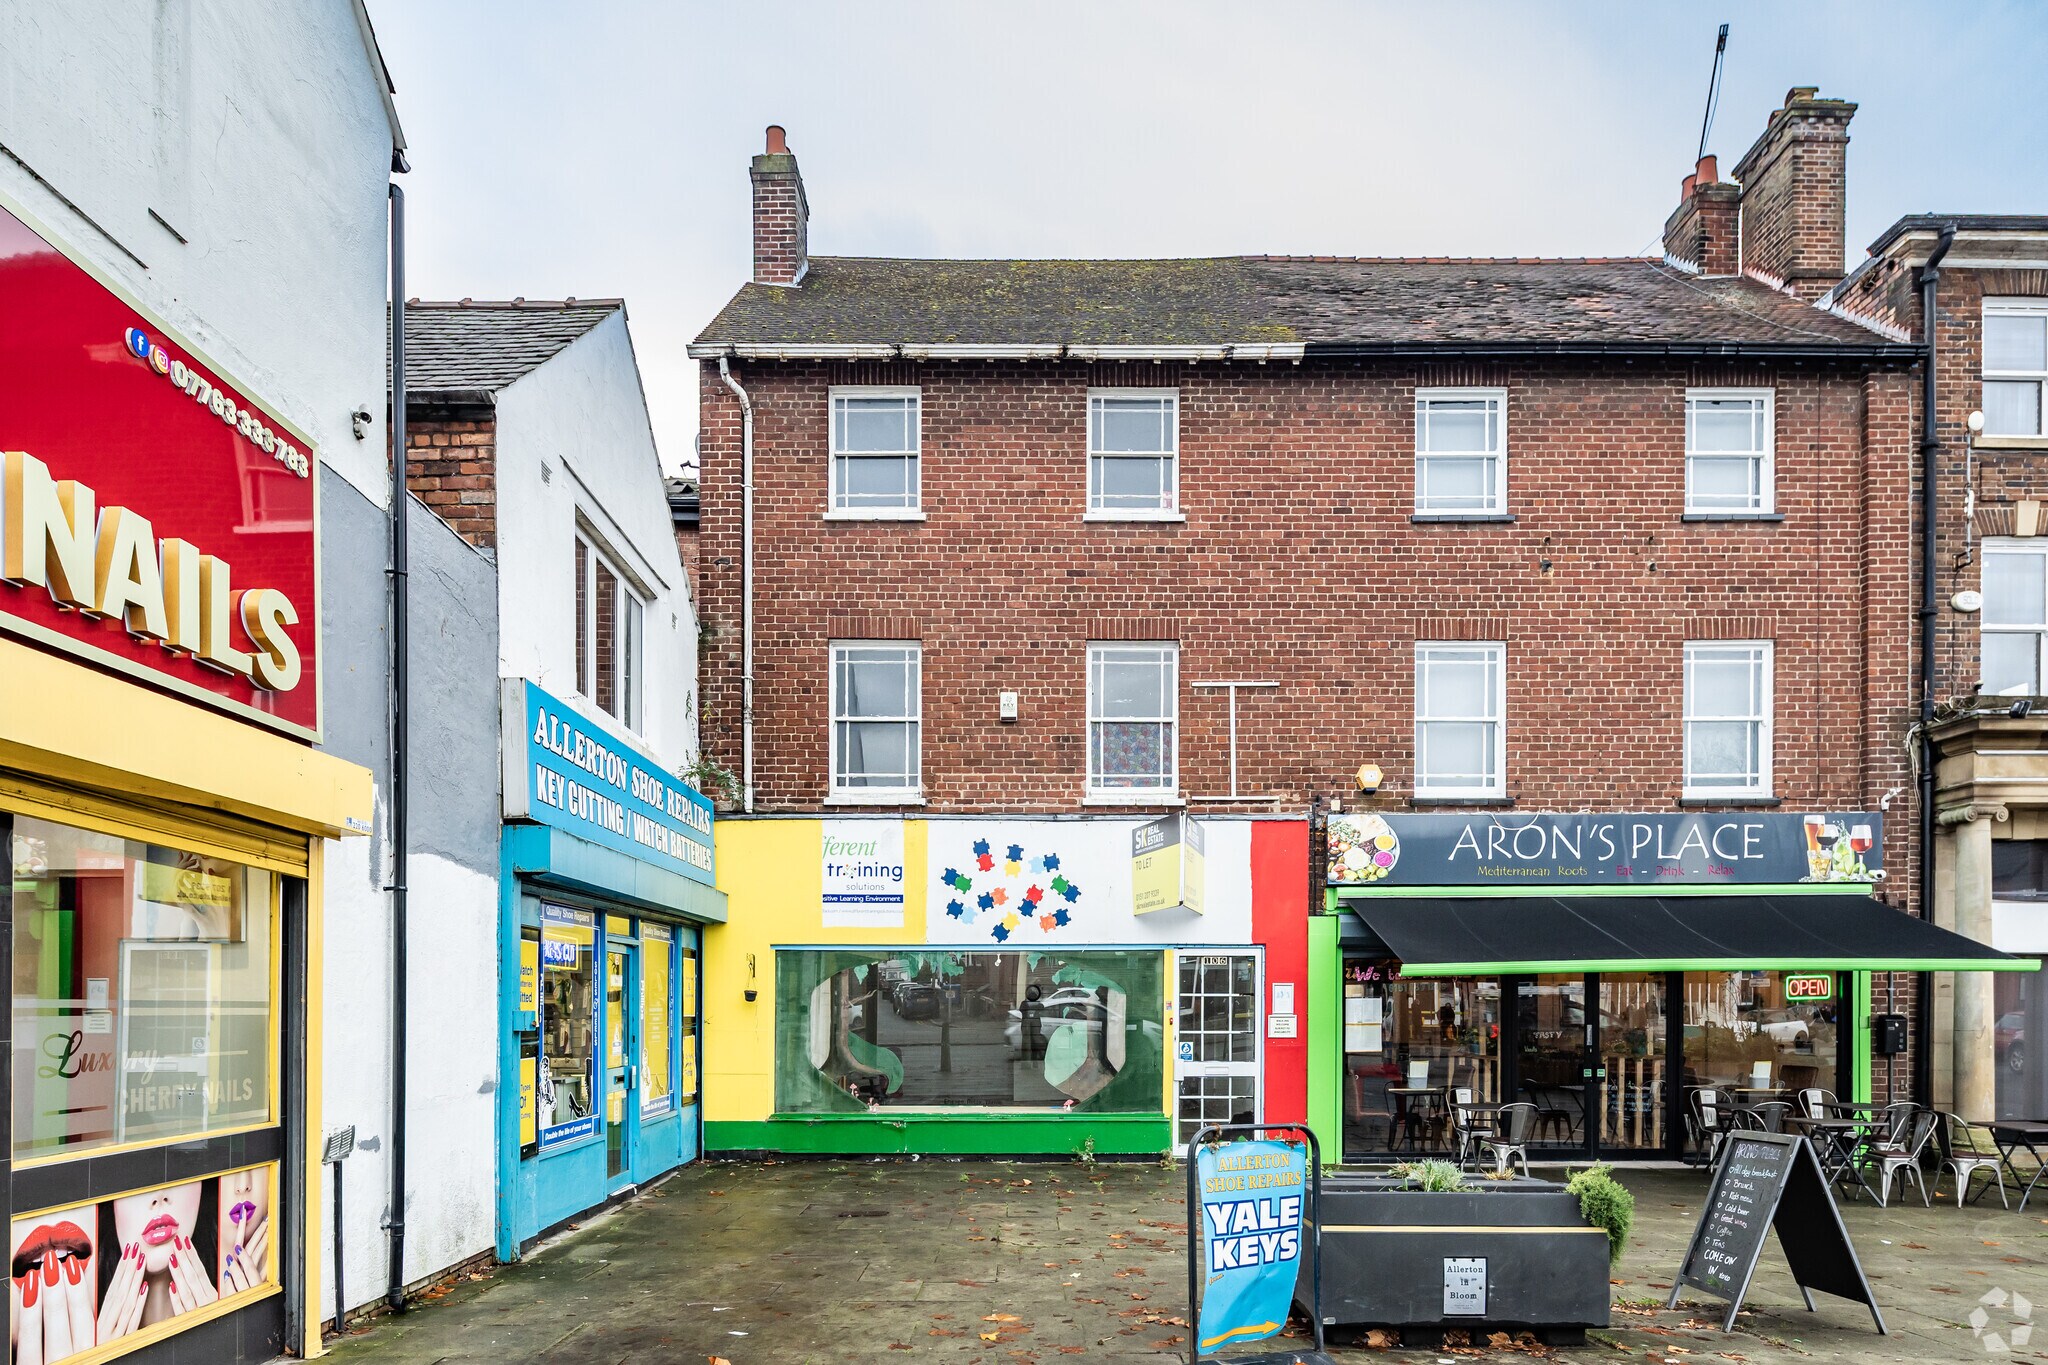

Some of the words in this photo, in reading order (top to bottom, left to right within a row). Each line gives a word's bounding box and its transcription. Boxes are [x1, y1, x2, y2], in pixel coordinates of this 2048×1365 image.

[172, 359, 237, 426] 07763
[237, 409, 275, 453] 333
[274, 437, 309, 478] 783
[4, 451, 301, 692] NAILS
[534, 706, 627, 792] ALLERTON
[631, 765, 664, 811] SHOE
[666, 786, 711, 836] REPAIRS
[536, 763, 565, 811] KEY
[568, 779, 624, 836] CUTTING
[632, 811, 668, 855] WATCH
[670, 830, 712, 873] BATTERIES
[1135, 828, 1148, 850] SK
[1147, 823, 1160, 836] REAL
[1147, 832, 1164, 846] ESTATE
[1448, 823, 1615, 861] ARON'S
[1632, 823, 1765, 861] PLACE
[823, 835, 877, 860] ferent
[1135, 860, 1143, 870] TO
[1143, 857, 1152, 869] LET
[1477, 865, 1551, 877] Mediterranean
[1558, 866, 1588, 876] Roots
[1616, 865, 1633, 876] Eat
[1656, 863, 1685, 878] Drink
[1707, 865, 1735, 876] Relax
[846, 883, 885, 891] solutions
[839, 895, 864, 904] Learning
[546, 905, 562, 919] Quality
[563, 909, 574, 919] Shoe
[574, 911, 590, 923] Repairs
[562, 943, 576, 961] CUT
[1203, 956, 1228, 966] 106
[1788, 979, 1828, 996] OPEN
[202, 1078, 253, 1106] NAILS
[545, 1130, 558, 1141] Double
[1218, 1153, 1291, 1172] ALLERTON
[1205, 1176, 1245, 1194] SHOE
[1248, 1171, 1302, 1190] REPAIRS
[1204, 1194, 1302, 1237] YALE
[1724, 1203, 1737, 1213] Cold
[1211, 1228, 1299, 1273] KEYS
[1703, 1249, 1725, 1263] COME
[1724, 1256, 1738, 1265] ON
[1446, 1265, 1484, 1273] Allerton
[1707, 1264, 1719, 1275] IN
[1450, 1291, 1478, 1300] Bloom
